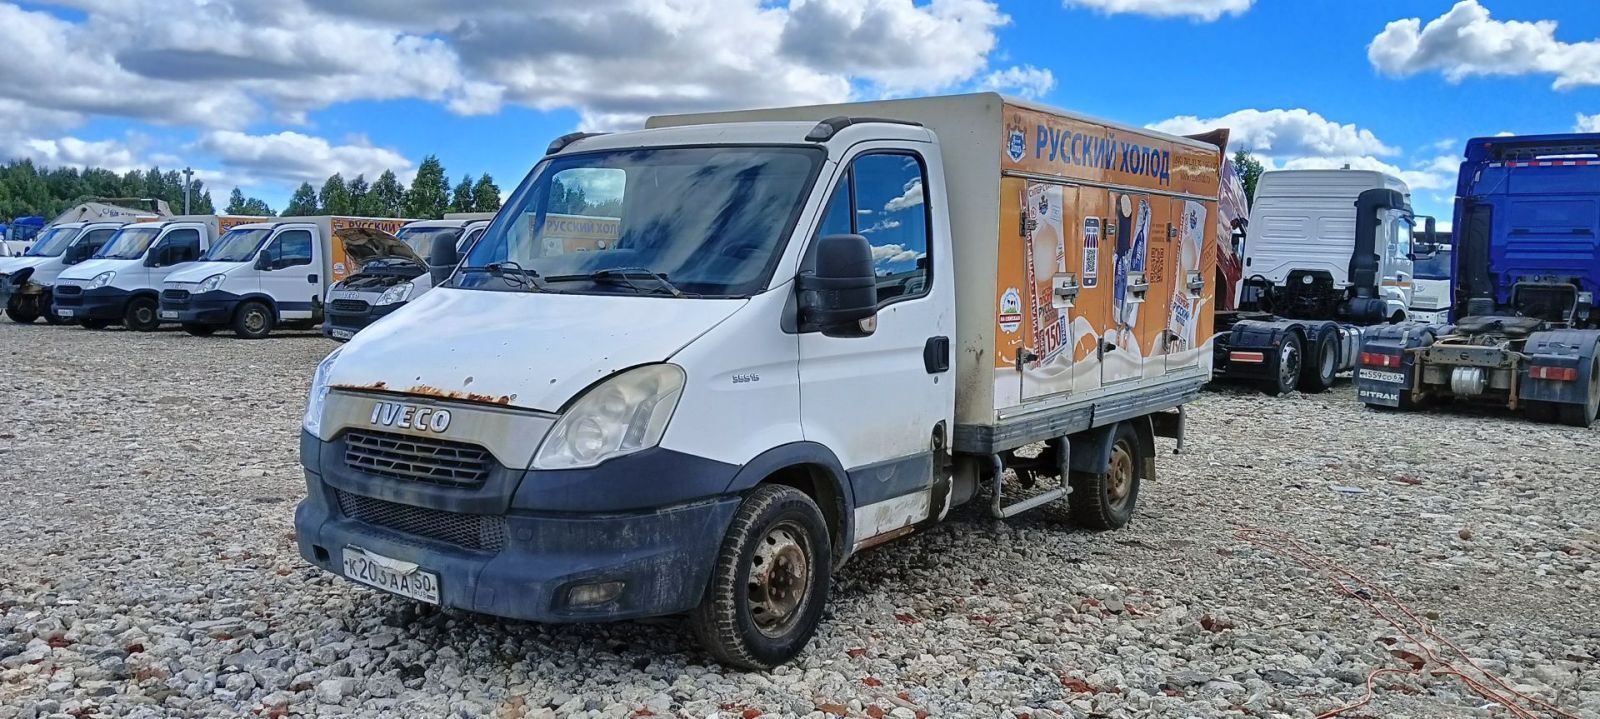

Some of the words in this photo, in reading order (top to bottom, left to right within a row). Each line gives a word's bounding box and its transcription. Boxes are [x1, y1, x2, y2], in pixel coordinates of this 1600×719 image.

[1036, 124, 1116, 171] РУССКИЙ
[1120, 142, 1170, 186] ХОЛОД
[1045, 321, 1061, 353] 150
[1360, 390, 1398, 400] SITRAK
[371, 402, 451, 432] IVECO
[414, 573, 431, 592] 50
